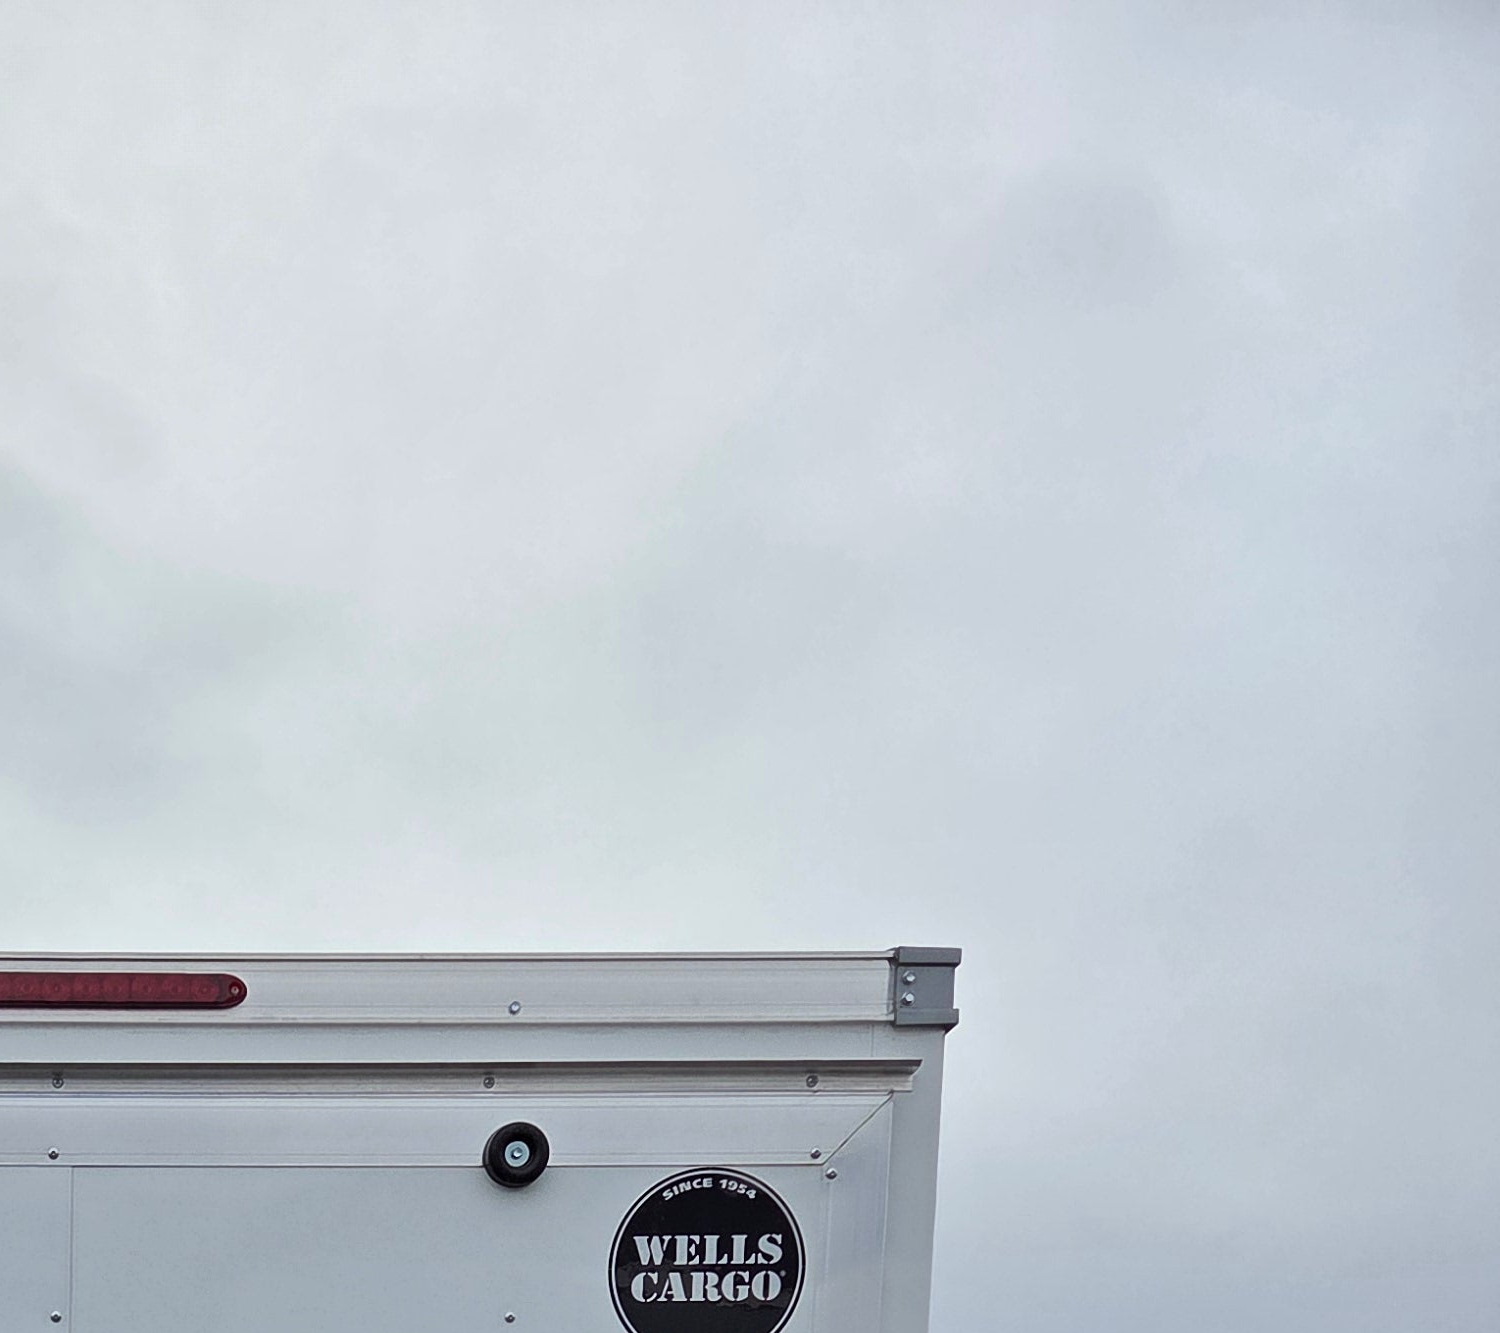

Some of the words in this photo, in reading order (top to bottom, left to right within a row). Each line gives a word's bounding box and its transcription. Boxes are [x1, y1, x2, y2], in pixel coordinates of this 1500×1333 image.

[662, 1177, 713, 1201] SINCE
[719, 1178, 757, 1200] 1954
[633, 1233, 783, 1266] WELLS
[630, 1270, 782, 1303] CARGO
